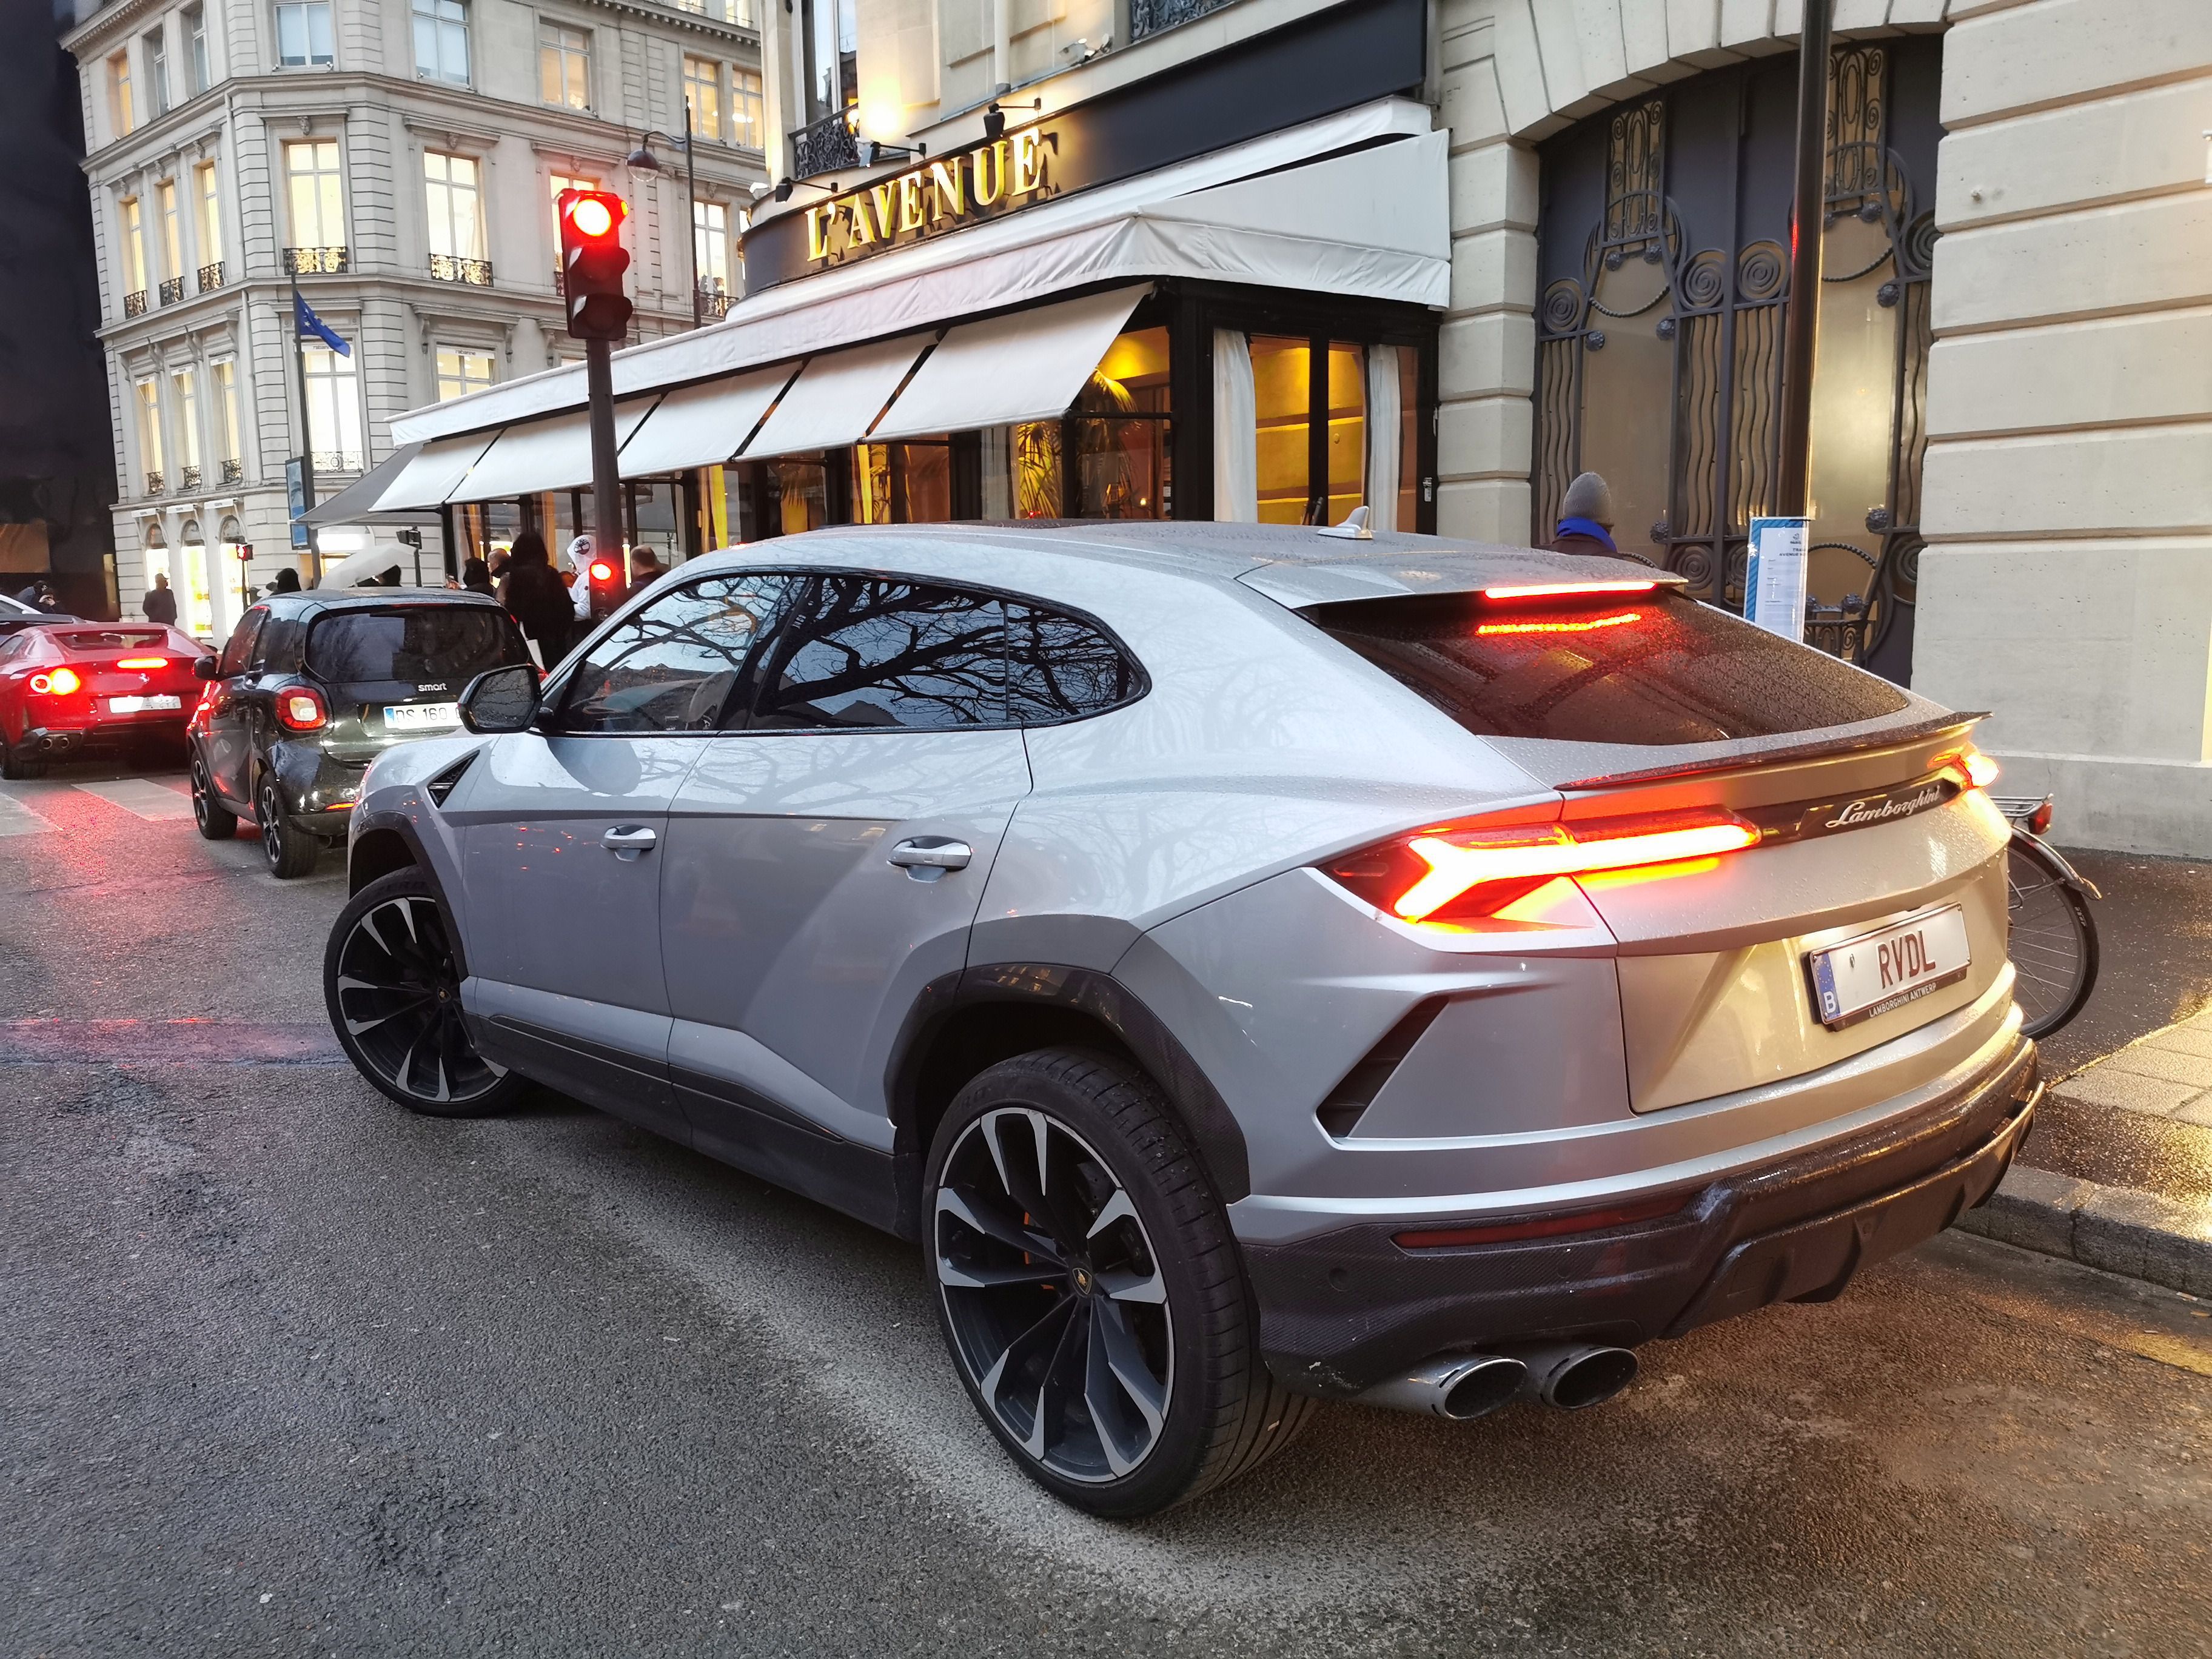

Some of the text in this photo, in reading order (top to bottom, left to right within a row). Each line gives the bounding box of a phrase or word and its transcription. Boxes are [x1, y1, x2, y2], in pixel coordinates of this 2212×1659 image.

[418, 682, 447, 692] smart
[396, 709, 415, 723] DS
[423, 707, 447, 720] 160
[1825, 785, 1940, 828] Lamborghini
[1875, 927, 1936, 990] RVDL
[1823, 991, 1837, 1014] B
[1868, 982, 1937, 1018] LAMBORGHINI ANTWERP
